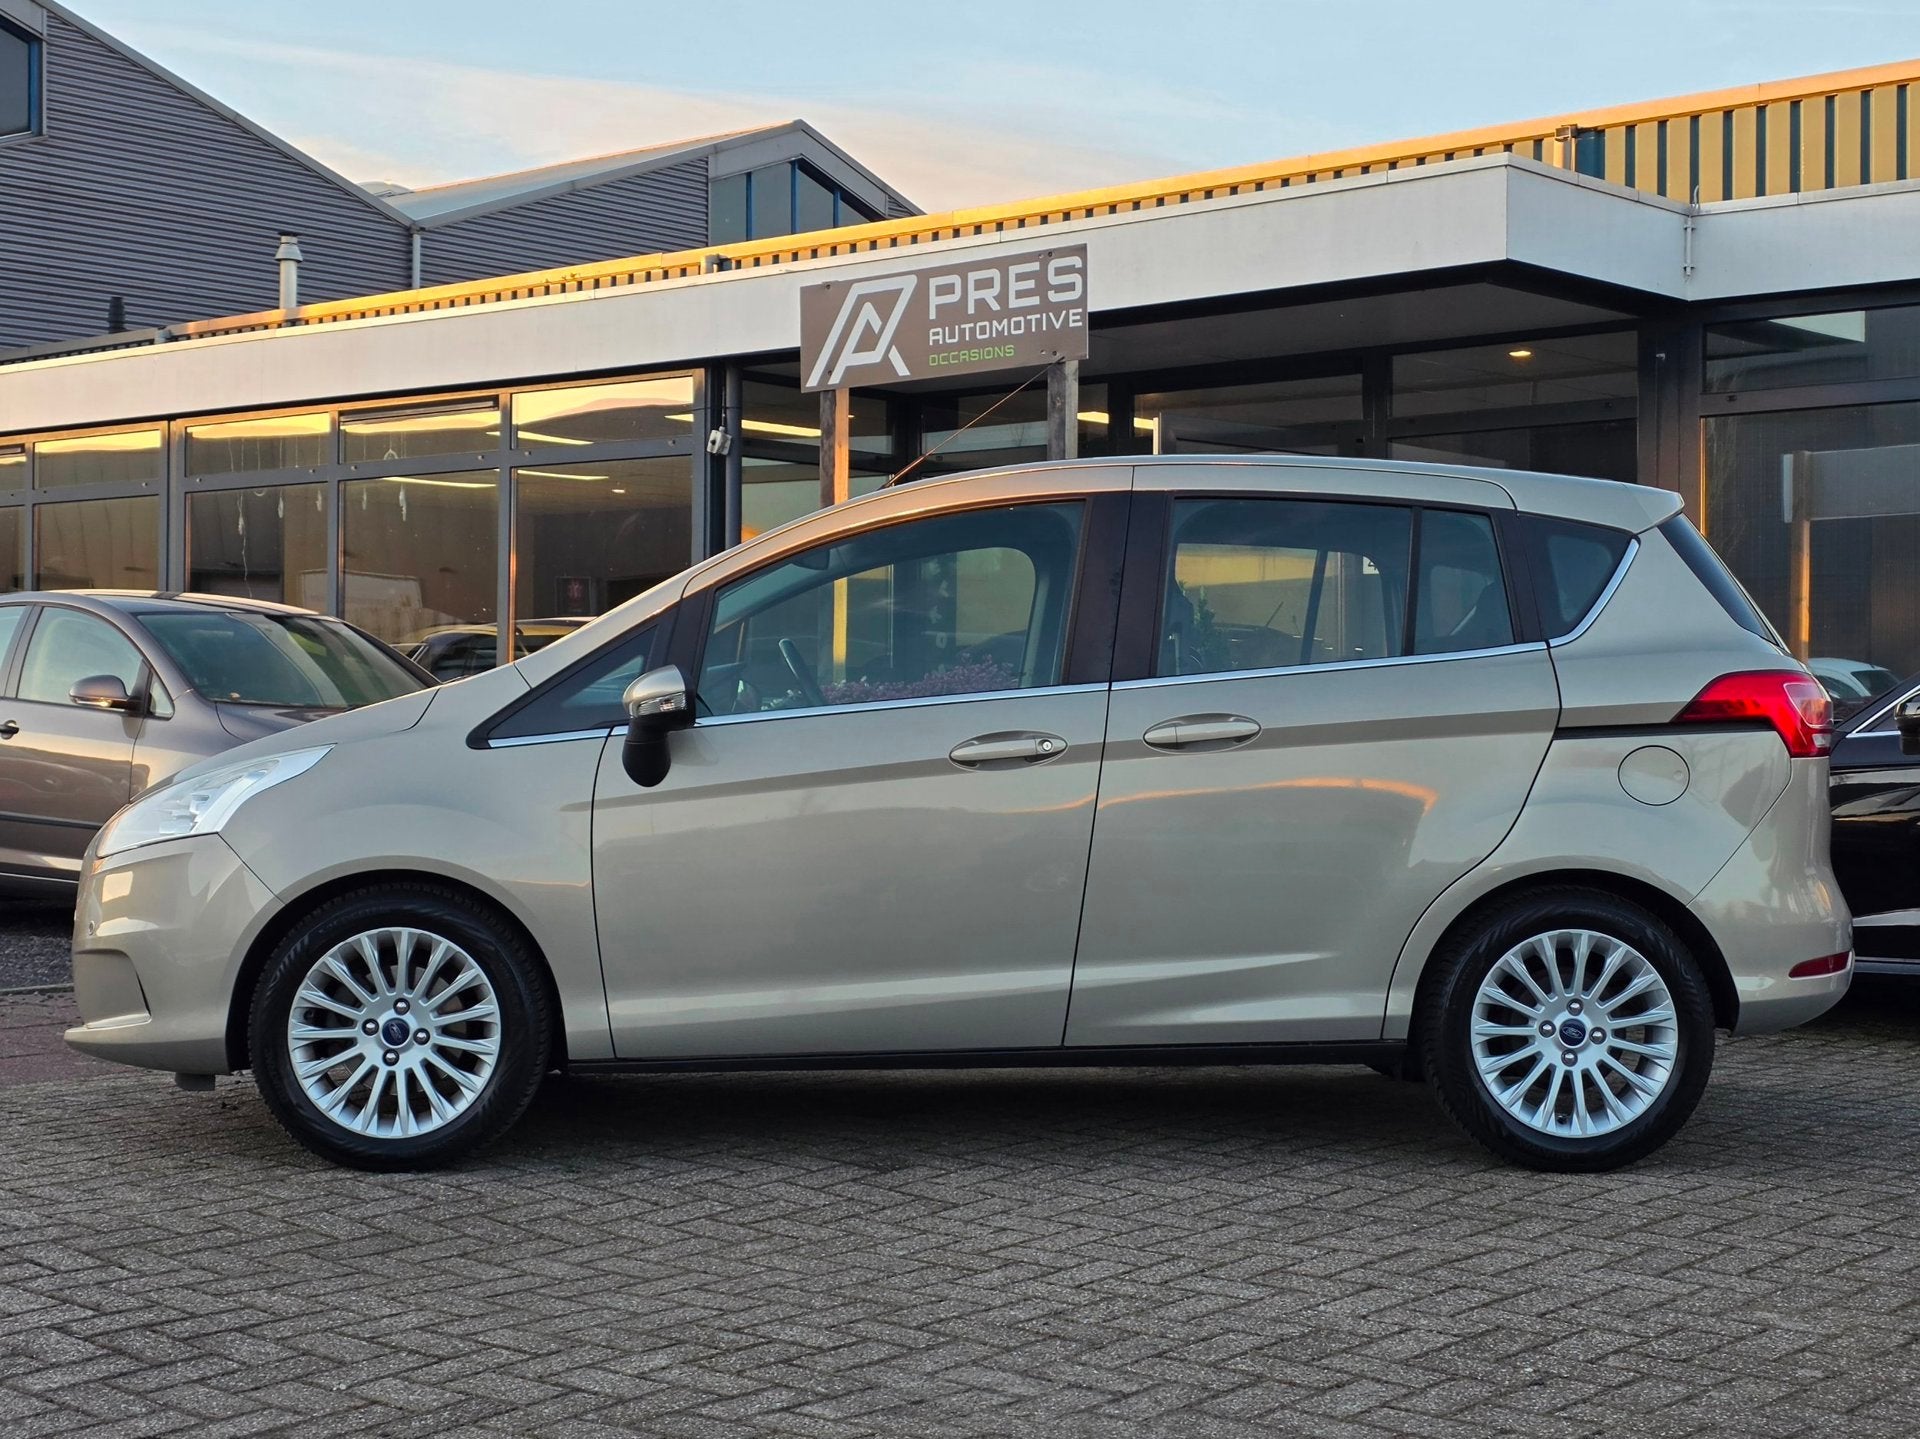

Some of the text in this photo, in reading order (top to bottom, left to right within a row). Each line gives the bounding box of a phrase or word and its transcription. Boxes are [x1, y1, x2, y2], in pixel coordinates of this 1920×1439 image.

[929, 255, 1083, 320] PRES
[929, 308, 1083, 346] AUTOMOTIVE
[929, 345, 1015, 366] OCCASIONS
